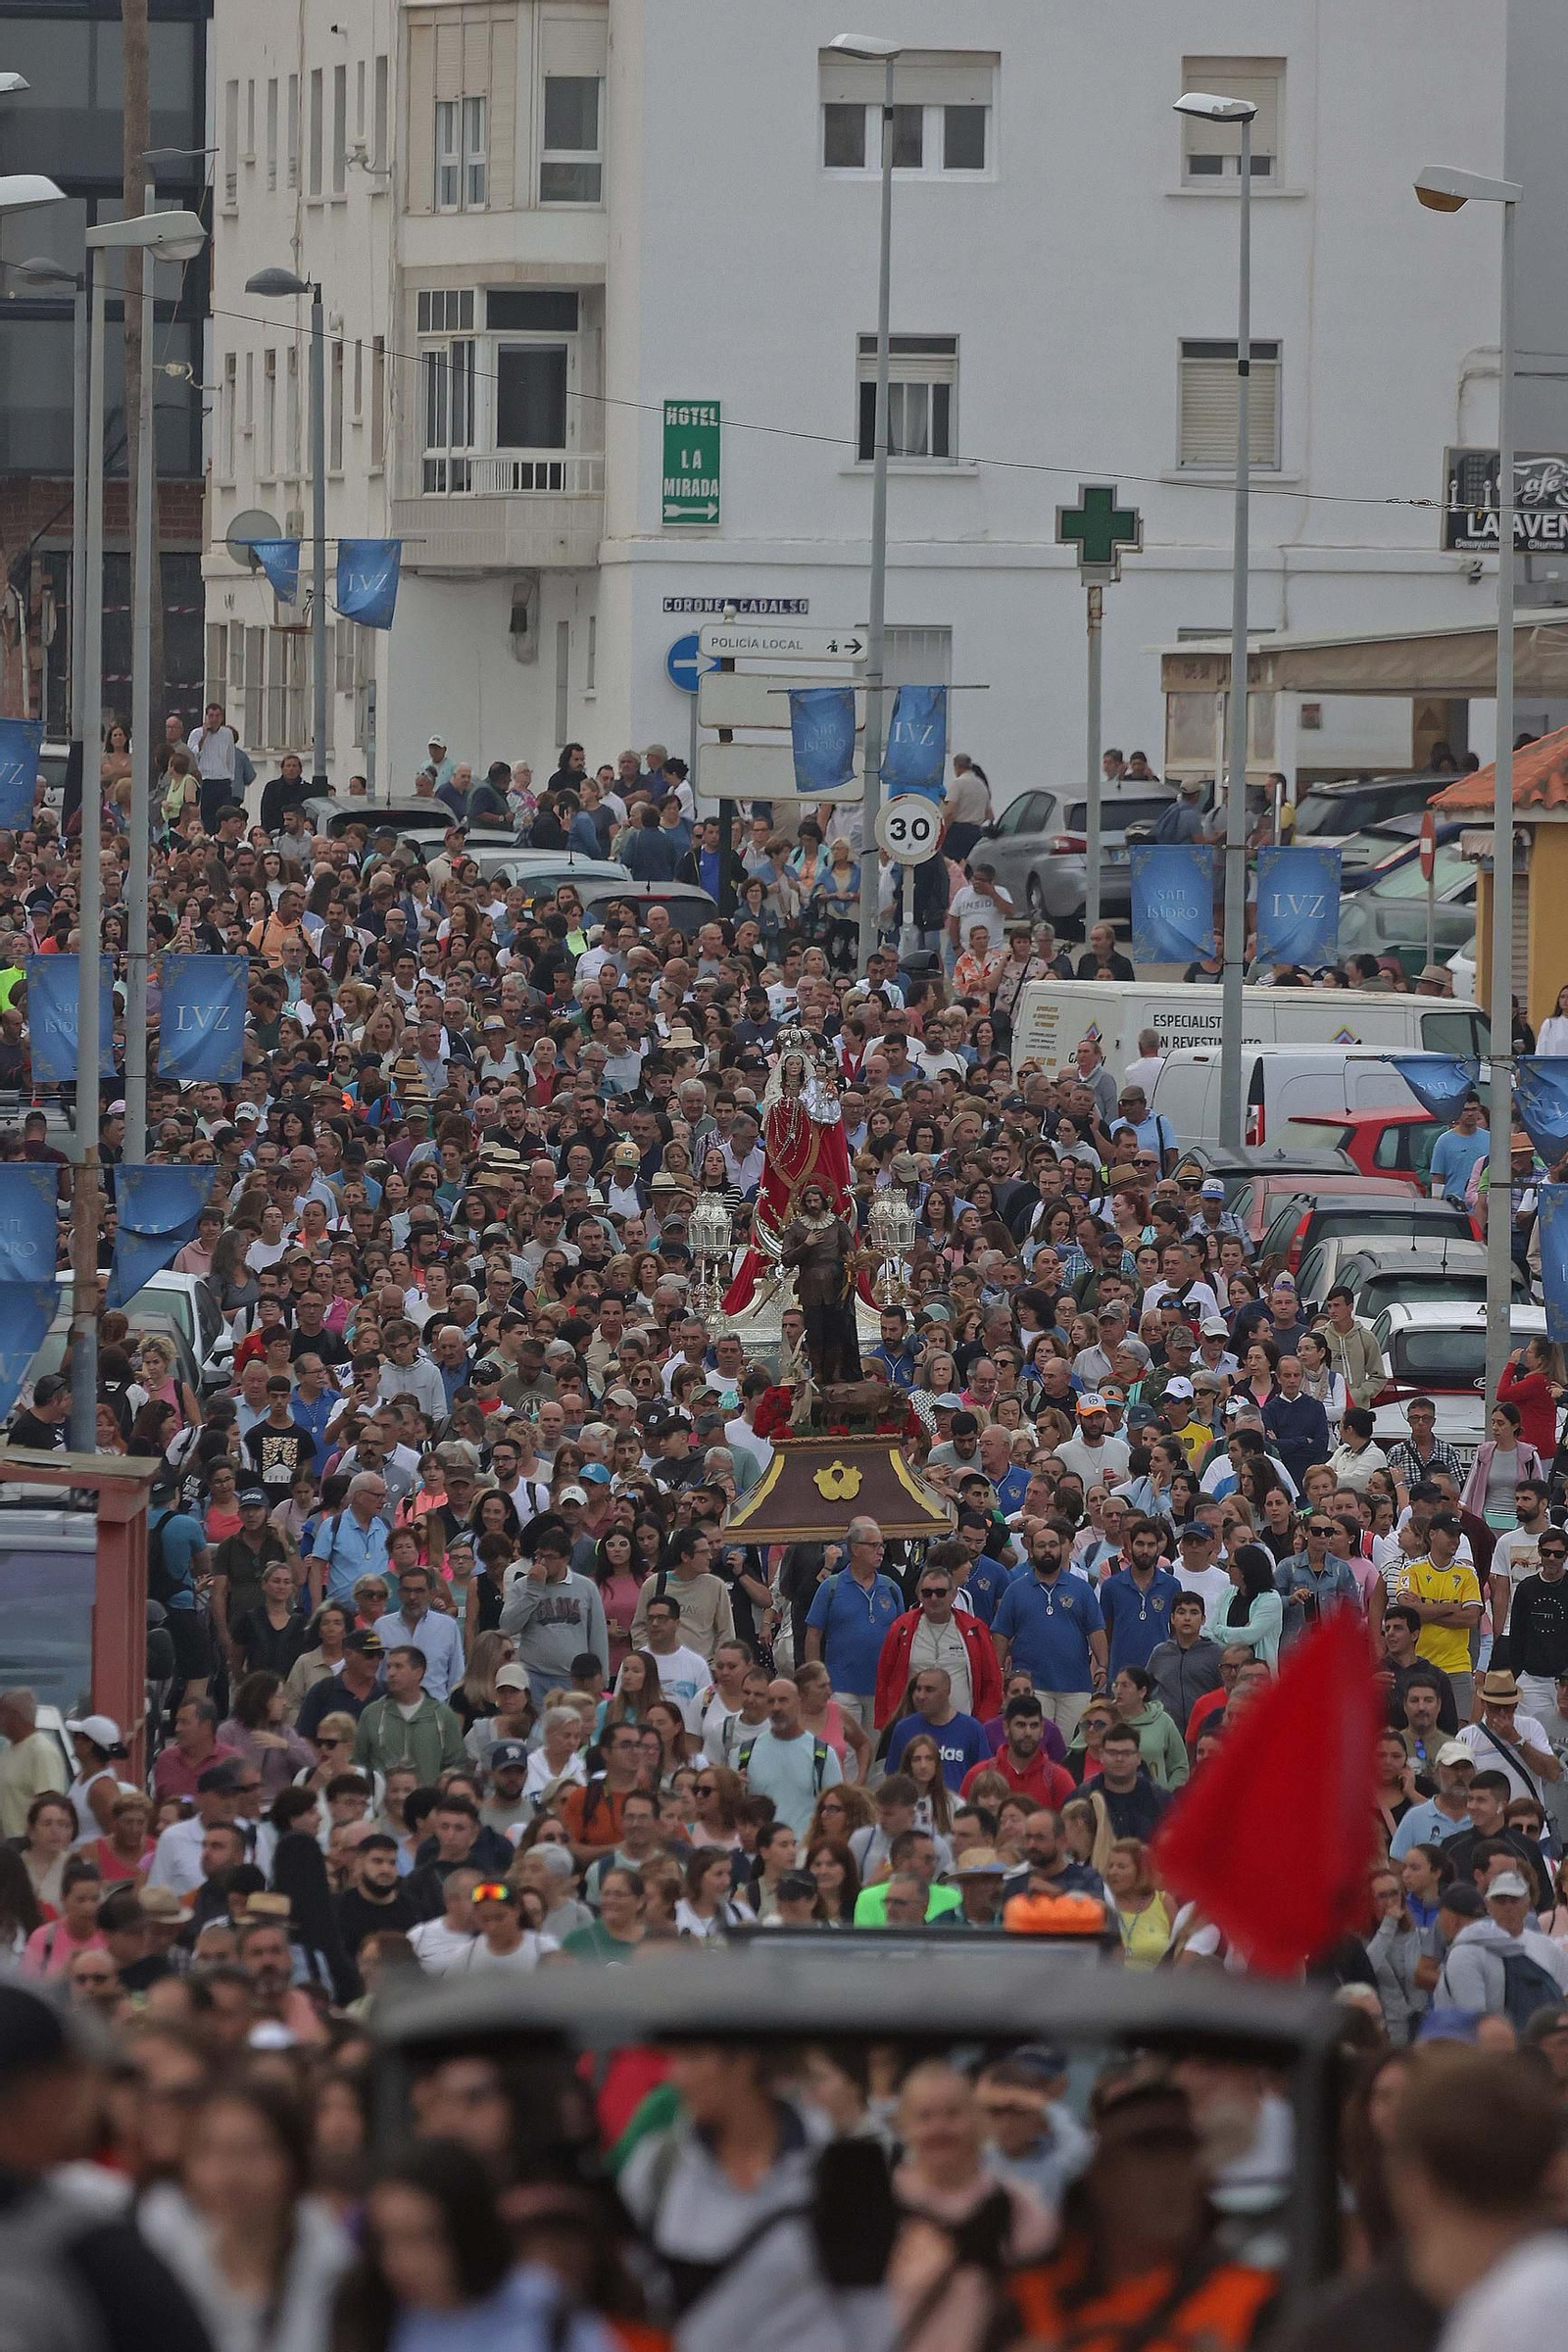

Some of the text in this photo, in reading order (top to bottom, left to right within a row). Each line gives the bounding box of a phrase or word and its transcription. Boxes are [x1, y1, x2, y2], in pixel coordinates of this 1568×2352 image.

[666, 406, 718, 426] HOTEL
[681, 449, 703, 469] LA
[663, 476, 719, 498] MIRADA
[1467, 512, 1500, 538] LA
[347, 571, 389, 593] LVZ
[739, 599, 808, 614] CADALSO
[710, 636, 804, 651] POLICÍA LOCAL
[894, 721, 935, 748] LVZ
[890, 817, 930, 841] 30
[962, 899, 992, 909] INSID
[1156, 888, 1187, 902] SAN
[1147, 904, 1199, 920] ISIDRO
[1272, 894, 1326, 919] LVZ
[174, 1005, 231, 1031] LVZ
[1153, 1014, 1223, 1029] ESPECIALIST
